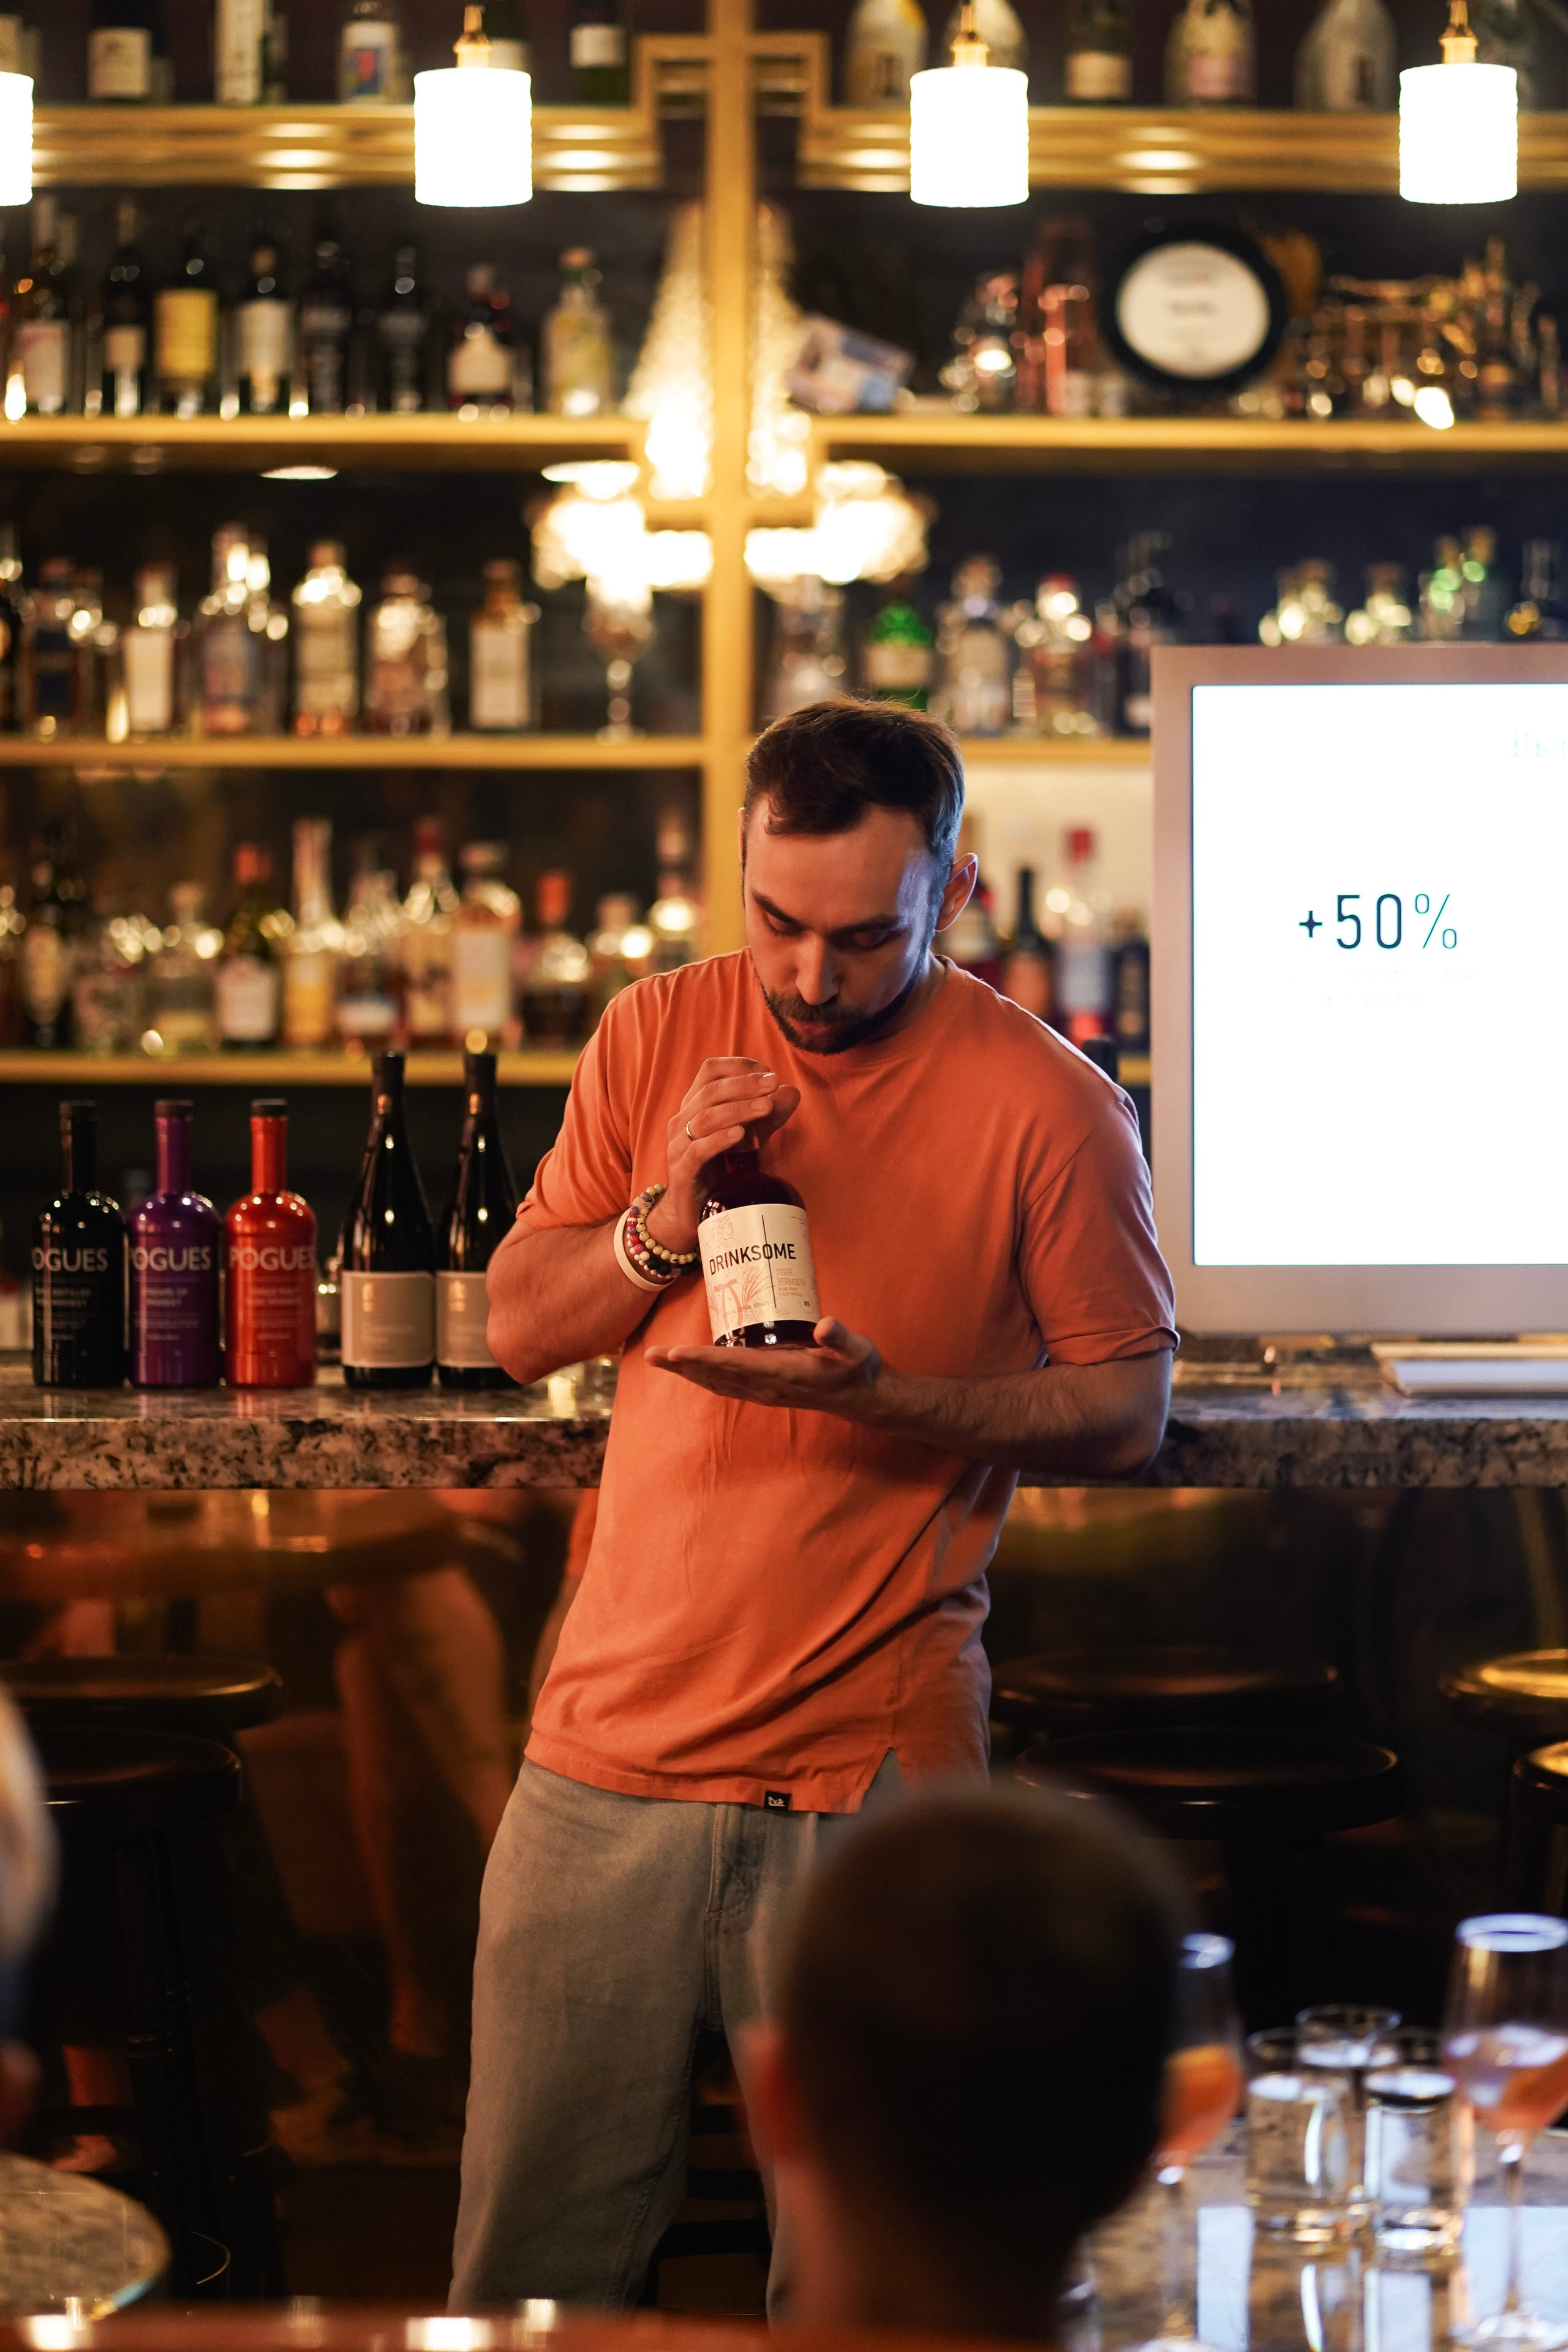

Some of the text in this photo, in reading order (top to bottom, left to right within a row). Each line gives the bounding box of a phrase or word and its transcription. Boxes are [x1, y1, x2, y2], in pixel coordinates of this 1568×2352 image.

[1298, 893, 1458, 950] +50%
[32, 1246, 108, 1272] OGUES
[130, 1246, 212, 1272] OGUES
[709, 1243, 797, 1276] DRINKSOME
